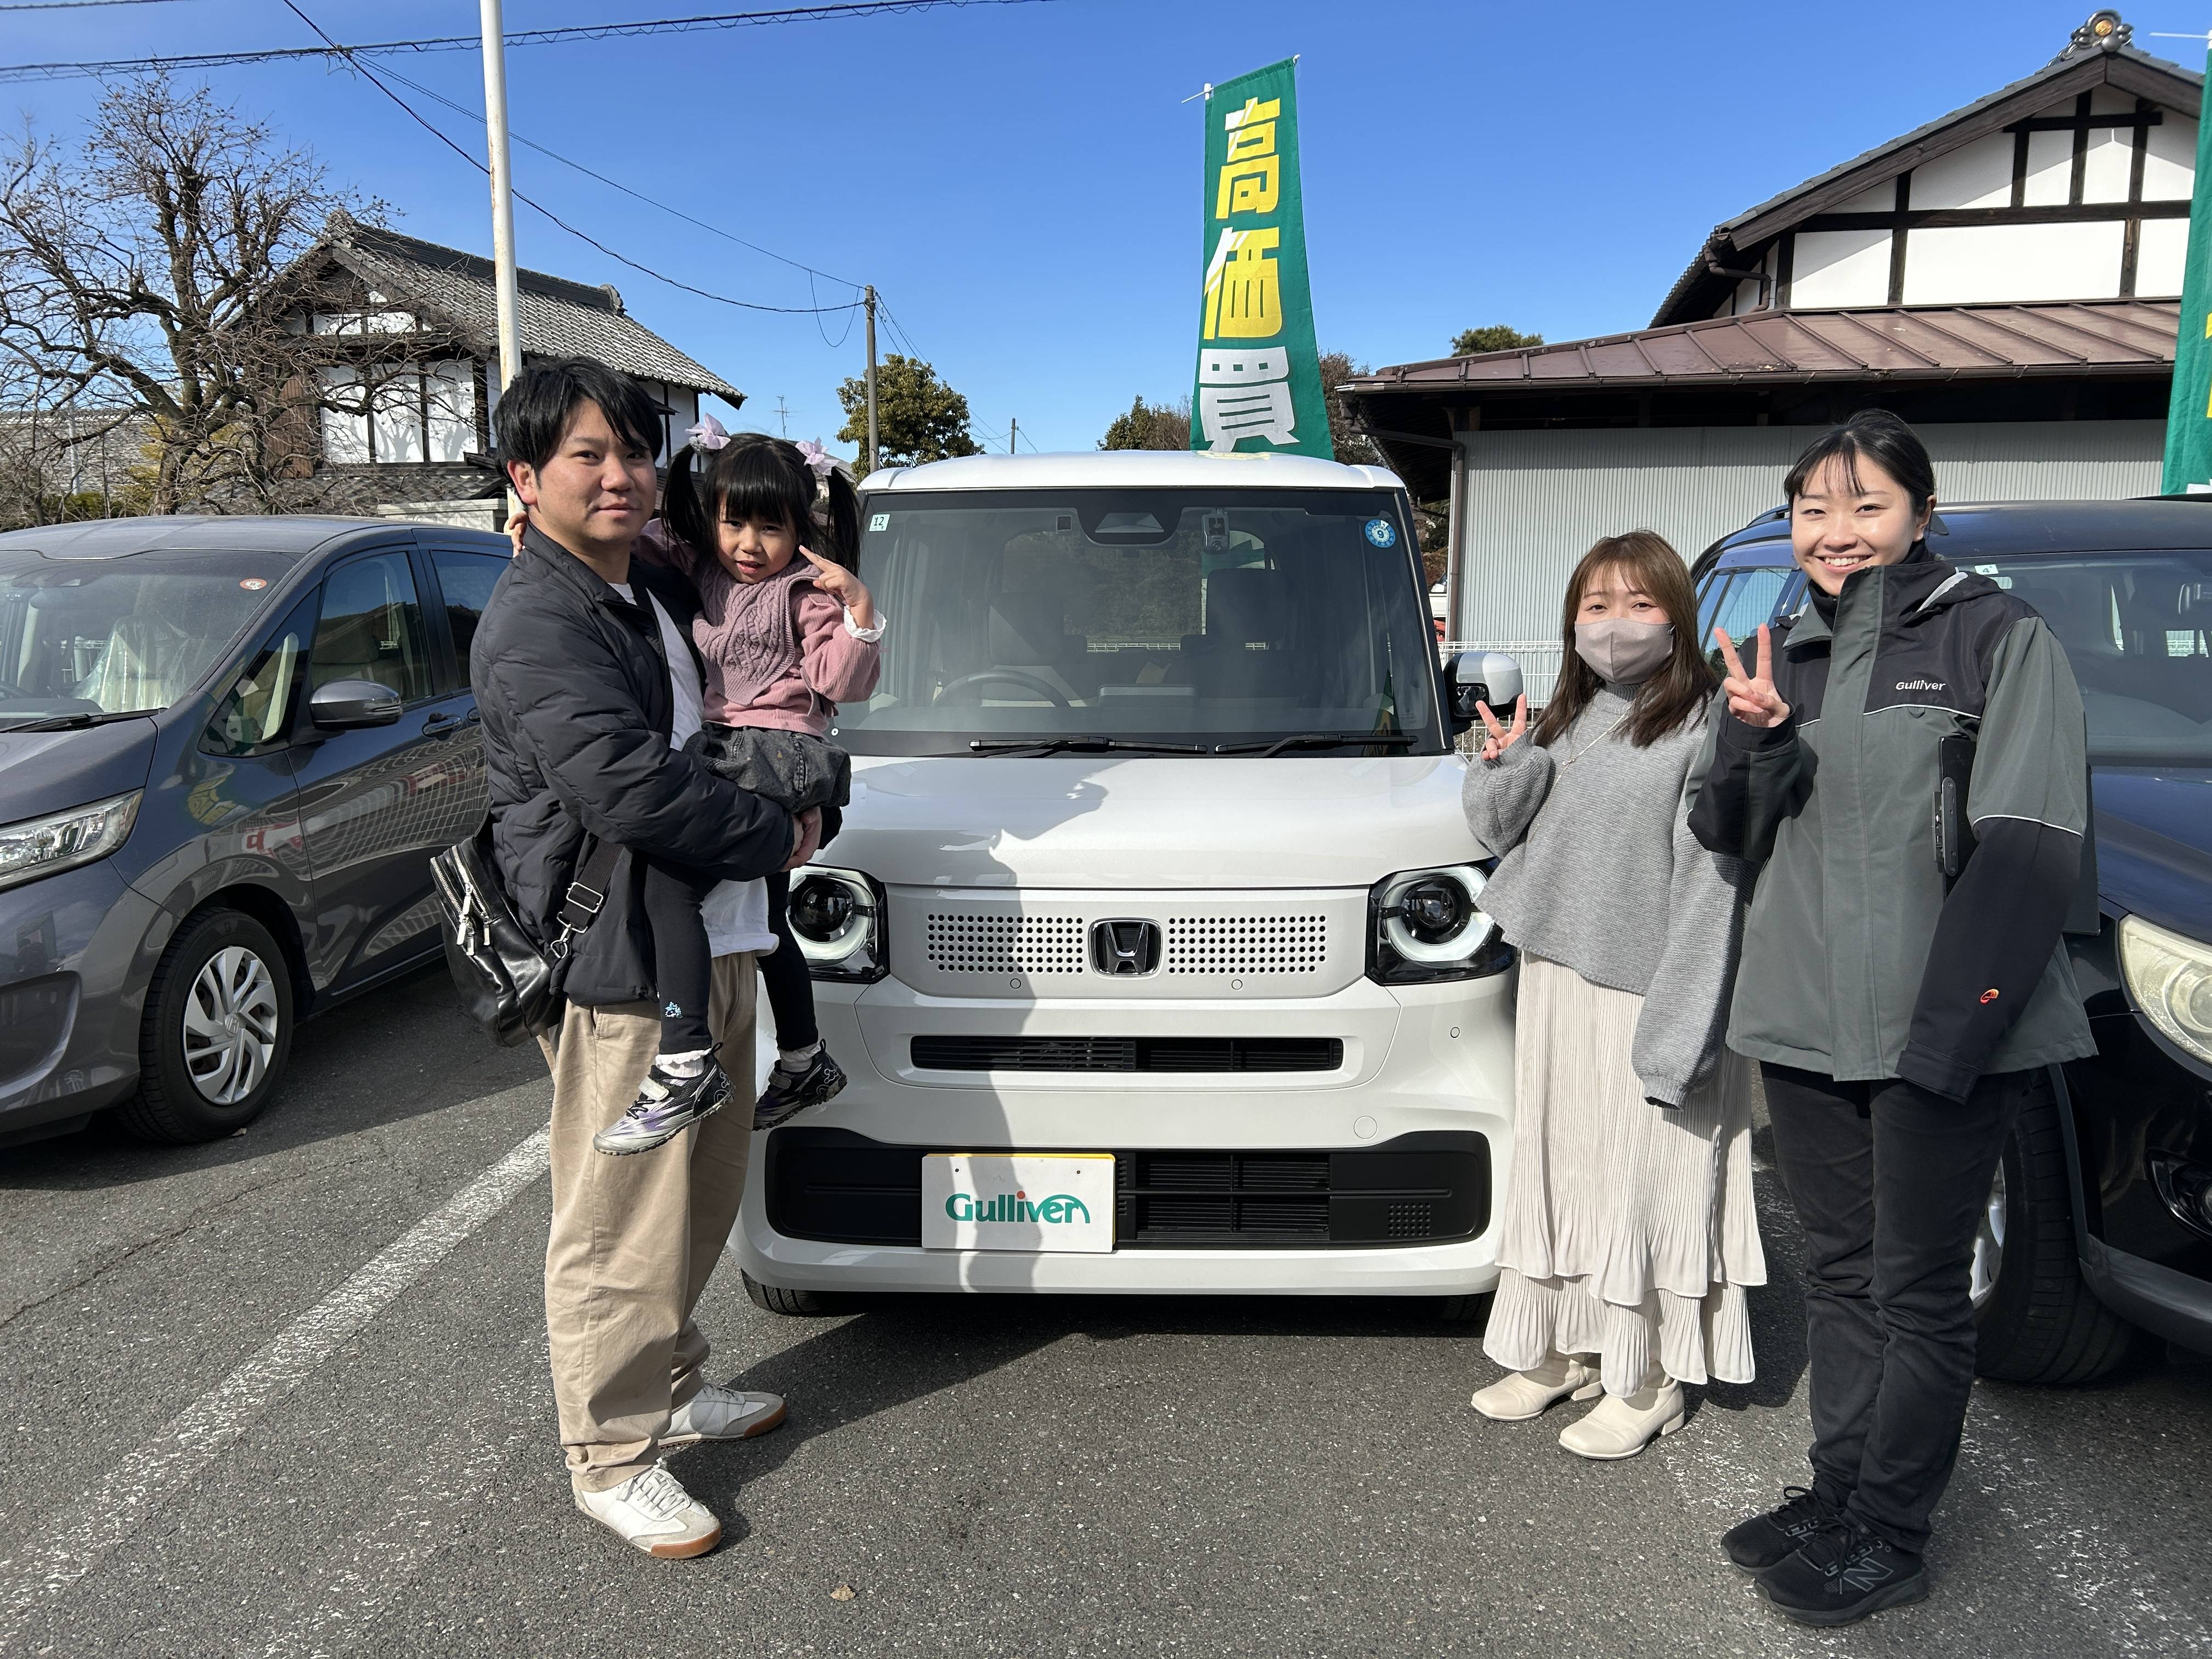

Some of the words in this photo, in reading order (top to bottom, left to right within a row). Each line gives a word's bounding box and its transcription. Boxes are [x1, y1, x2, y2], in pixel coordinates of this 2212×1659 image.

[1199, 97, 1300, 454] 高価買
[874, 516, 884, 526] 12
[1377, 530, 1384, 539] 9
[1895, 679, 1946, 691] Gulliver
[945, 1190, 1091, 1224] Gulliver
